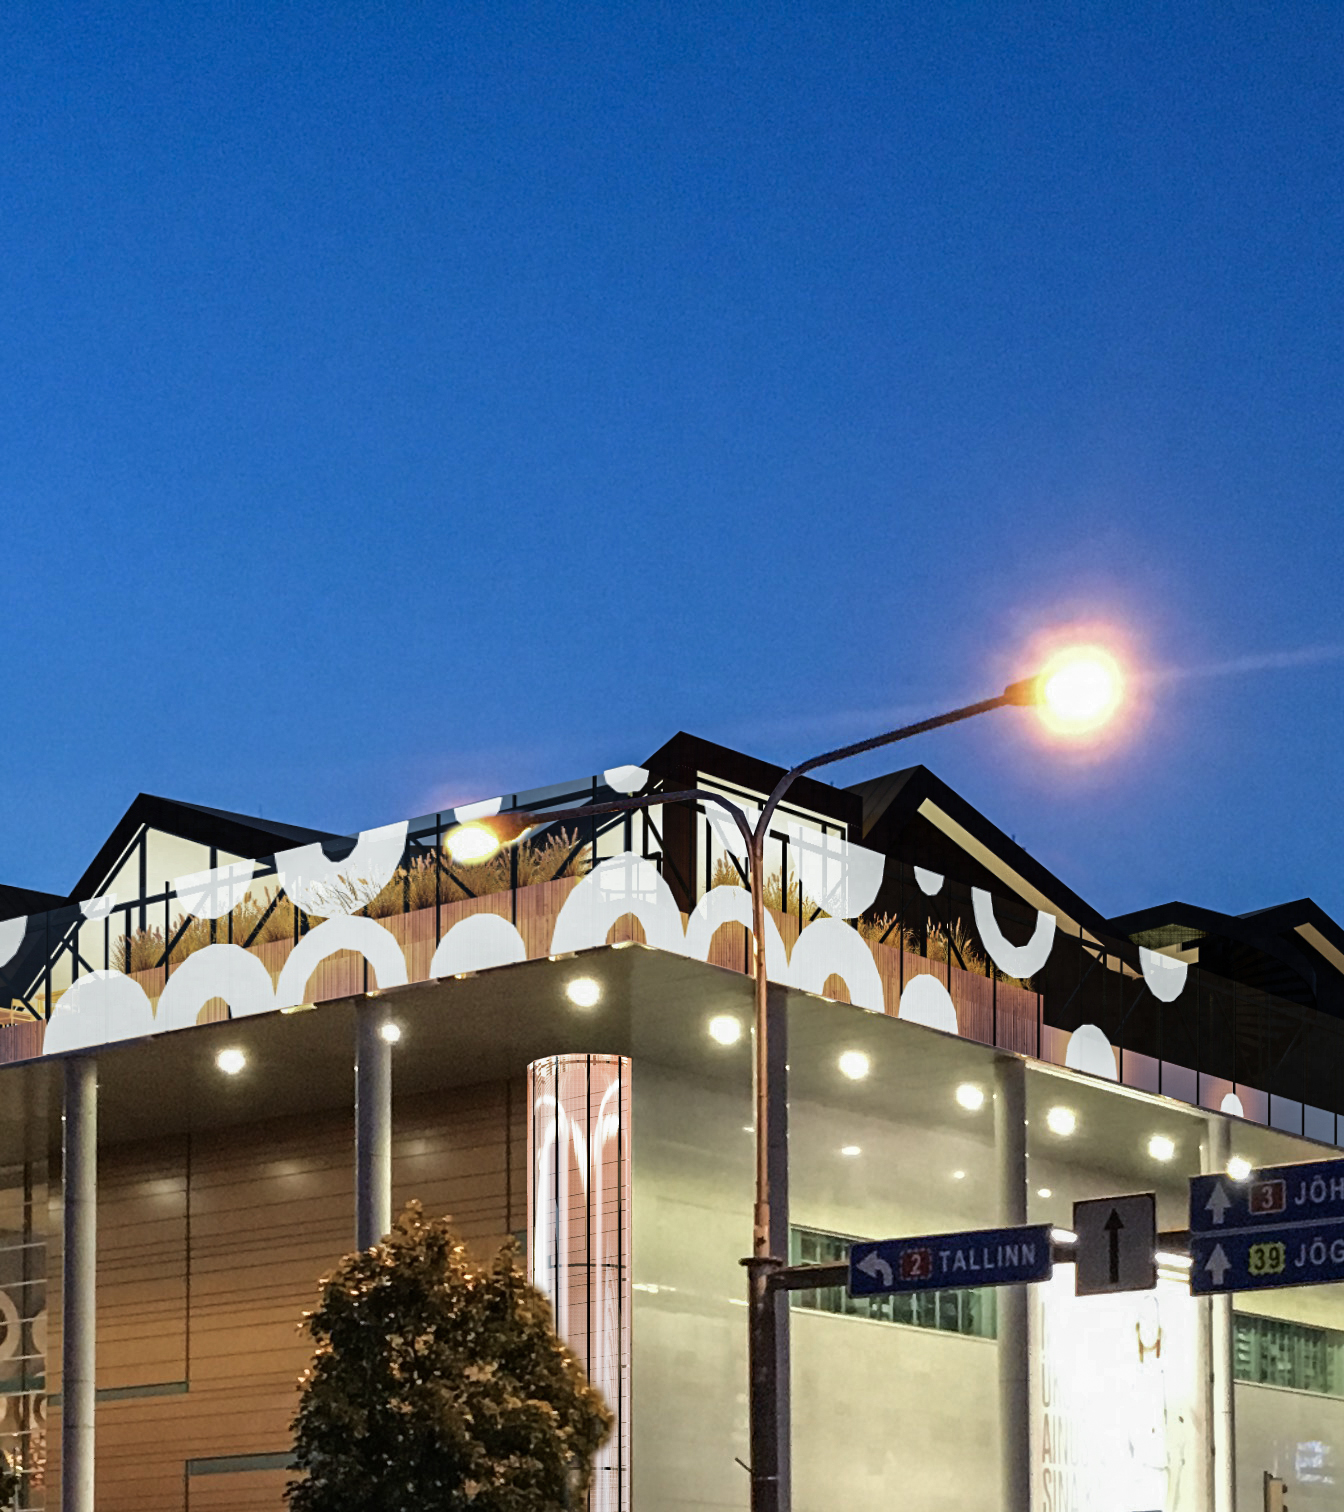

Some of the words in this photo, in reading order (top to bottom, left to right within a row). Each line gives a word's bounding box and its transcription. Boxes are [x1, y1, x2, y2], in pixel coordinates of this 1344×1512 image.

[1262, 1185, 1274, 1209] 3
[910, 1254, 922, 1275] 2
[939, 1243, 1036, 1272] TALLINN
[1255, 1246, 1281, 1271] 39
